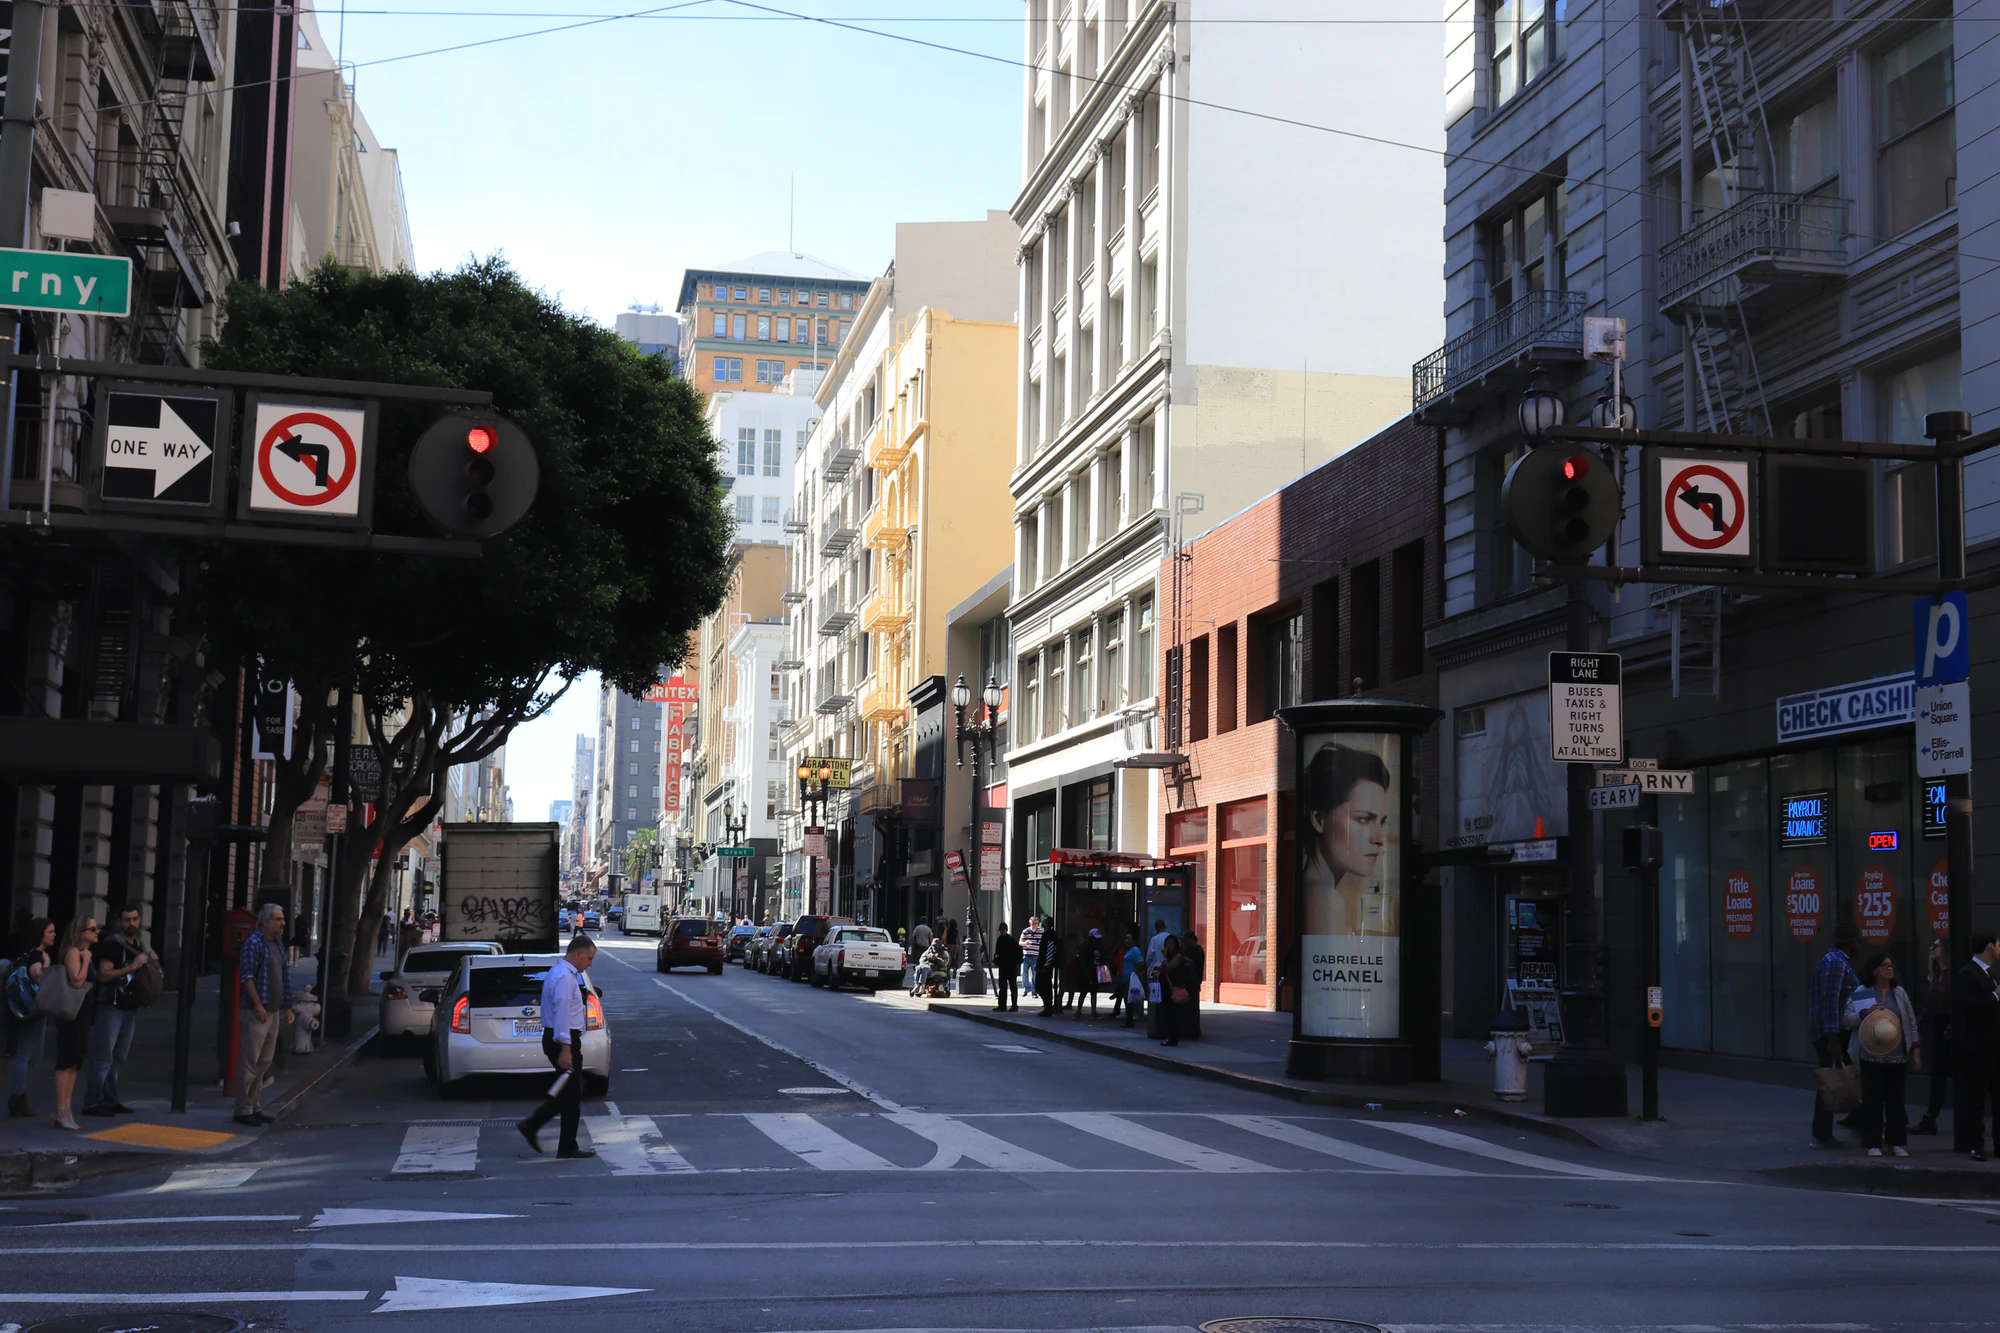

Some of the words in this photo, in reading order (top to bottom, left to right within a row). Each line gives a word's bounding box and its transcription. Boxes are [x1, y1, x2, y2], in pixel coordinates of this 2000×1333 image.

[12, 271, 97, 305] rny
[111, 439, 147, 456] ONE
[163, 442, 201, 460] WAY
[1571, 658, 1600, 668] RIGHT
[1572, 669, 1598, 679] LANE
[645, 686, 696, 700] BRITEX
[1568, 687, 1603, 697] BUSES
[1565, 699, 1594, 708] TAXIS
[1599, 700, 1606, 708] &
[1930, 700, 1953, 713] Union
[265, 717, 281, 725] FOR
[1570, 711, 1602, 721] RIGHT
[1779, 698, 1842, 733] CHECK
[1930, 712, 1958, 726] Square
[265, 726, 285, 734] EASE
[1569, 723, 1604, 733] TURNS
[1572, 735, 1600, 745] ONLY
[1931, 737, 1950, 748] Ellis-
[667, 706, 682, 808] FABRICS
[1558, 747, 1568, 755] AT
[1571, 747, 1589, 756] ALL
[1591, 748, 1617, 757] TIMES
[1932, 747, 1964, 761] O'Farrell
[807, 760, 849, 770] GRASTONE
[811, 770, 845, 780] HEL
[1606, 774, 1687, 789] ARNY
[1591, 788, 1637, 806] GEARY
[1788, 799, 1822, 819] PAYROLL
[296, 812, 305, 821] NO
[1786, 819, 1824, 837] ADVANCE
[1869, 834, 1895, 848] OPEN
[1864, 871, 1884, 881] Payday
[1729, 878, 1749, 893] Title
[1790, 877, 1815, 891] Loans
[1865, 881, 1883, 890] Loans
[1726, 895, 1752, 910] Loans
[1787, 893, 1820, 915] $5,000
[1857, 892, 1892, 917] $255
[1312, 955, 1383, 966] GABRIELLE
[1312, 969, 1383, 983] CHANEL
